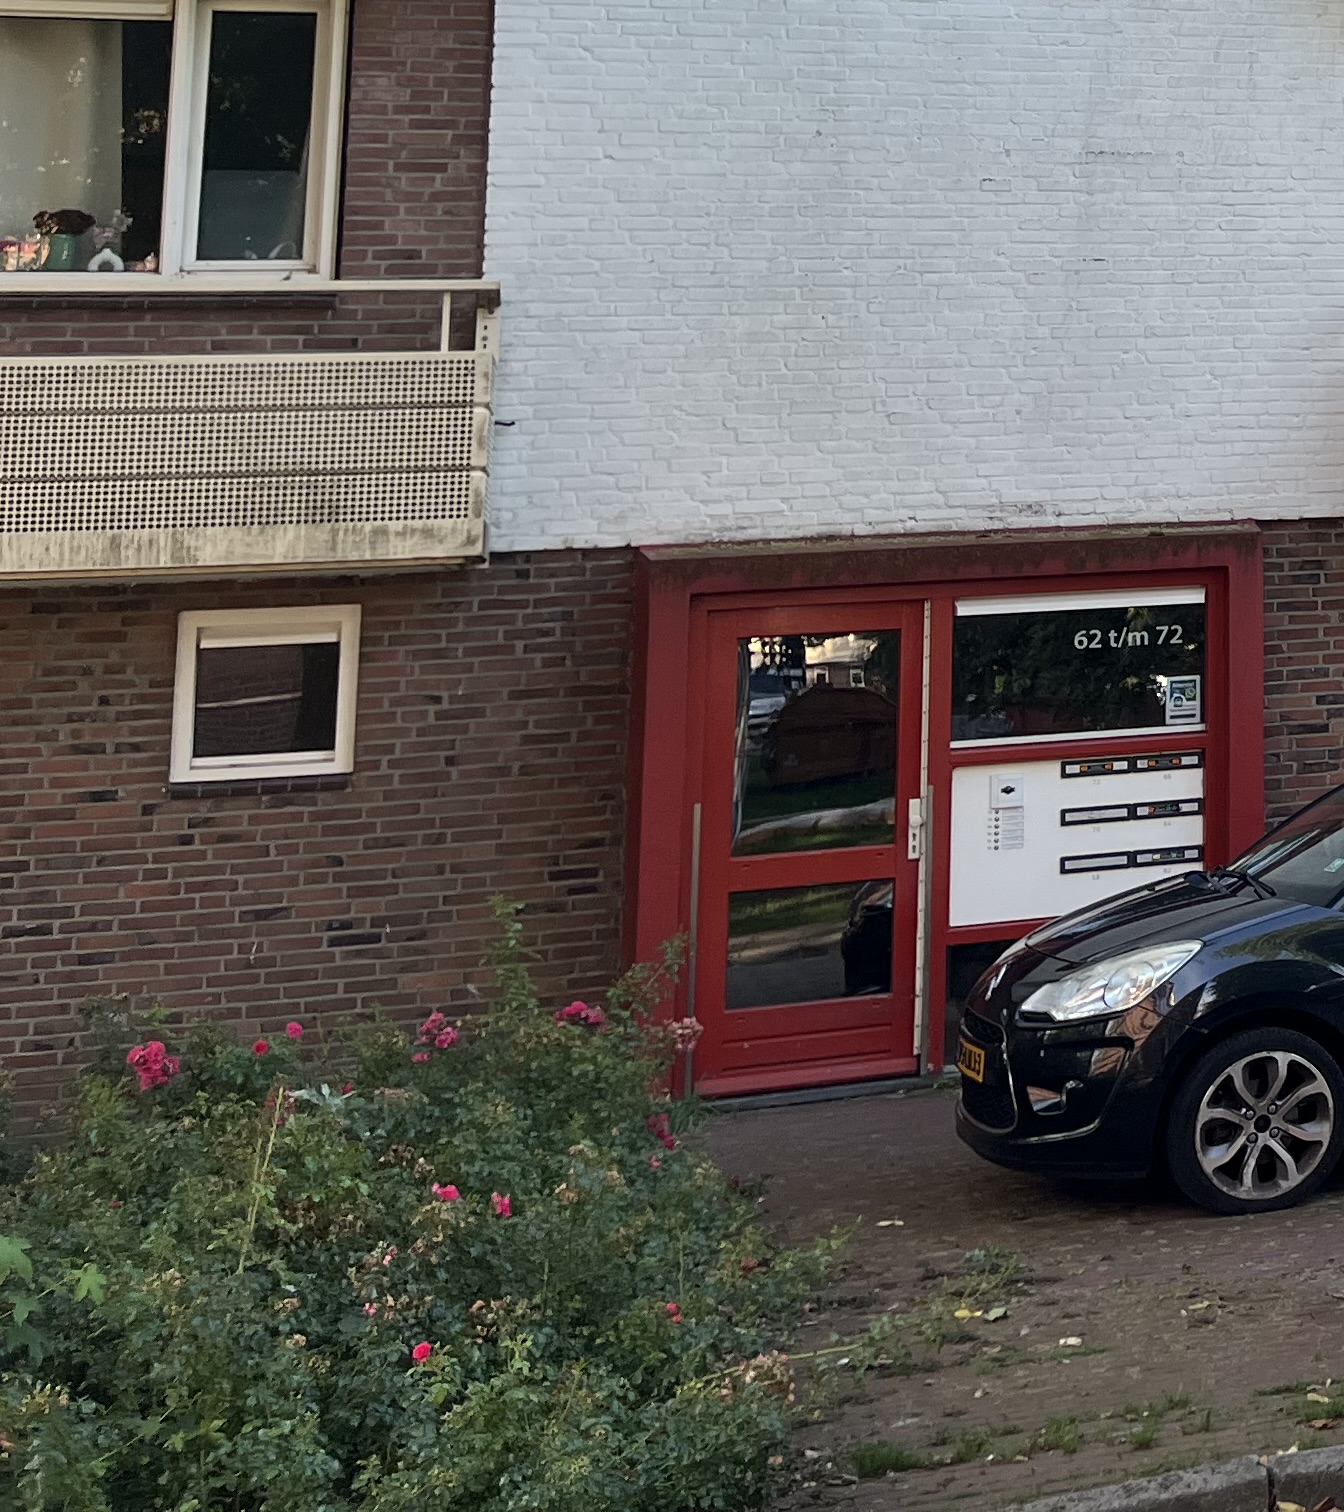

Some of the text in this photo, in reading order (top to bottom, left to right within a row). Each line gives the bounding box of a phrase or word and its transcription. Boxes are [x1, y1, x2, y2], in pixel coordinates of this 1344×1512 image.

[1073, 624, 1184, 650] 62 t/m 72
